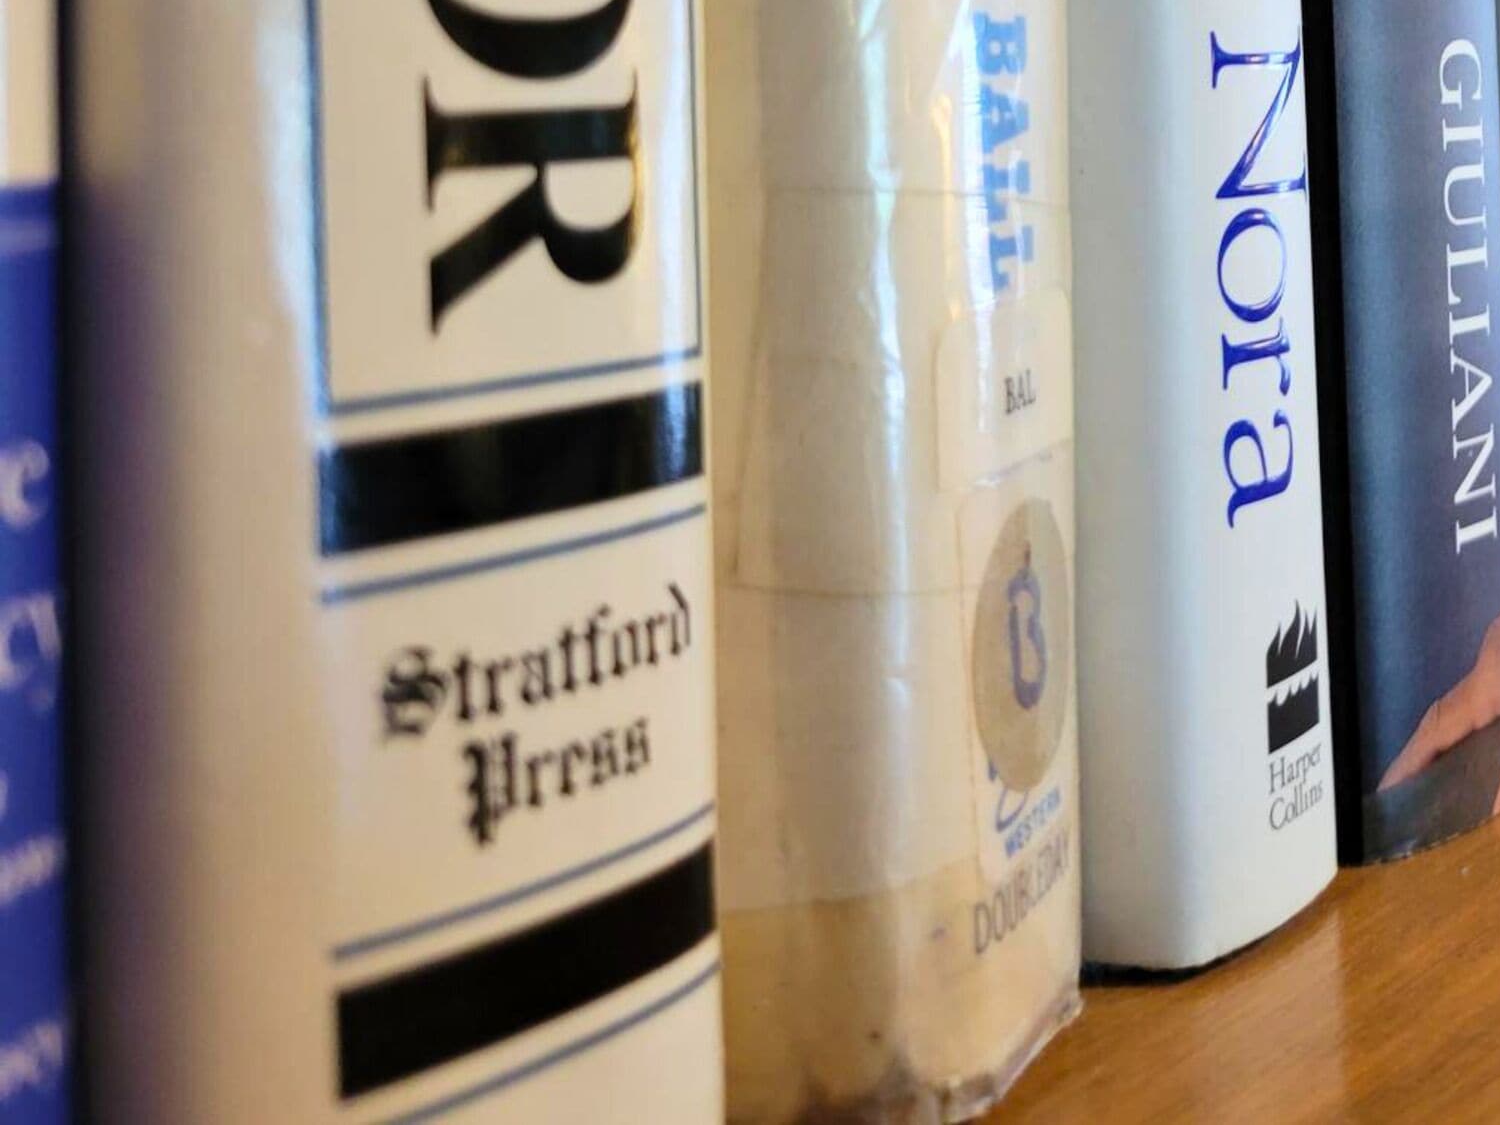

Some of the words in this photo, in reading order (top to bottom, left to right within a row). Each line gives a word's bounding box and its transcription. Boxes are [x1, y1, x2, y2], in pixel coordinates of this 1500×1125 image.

[1210, 30, 1309, 528] Nora
[1436, 38, 1499, 553] GIULIANI
[1004, 368, 1038, 415] BAL
[379, 582, 691, 742] Stratford
[462, 717, 652, 848] Press
[1268, 741, 1322, 796] Harper
[1269, 779, 1323, 831] Collins
